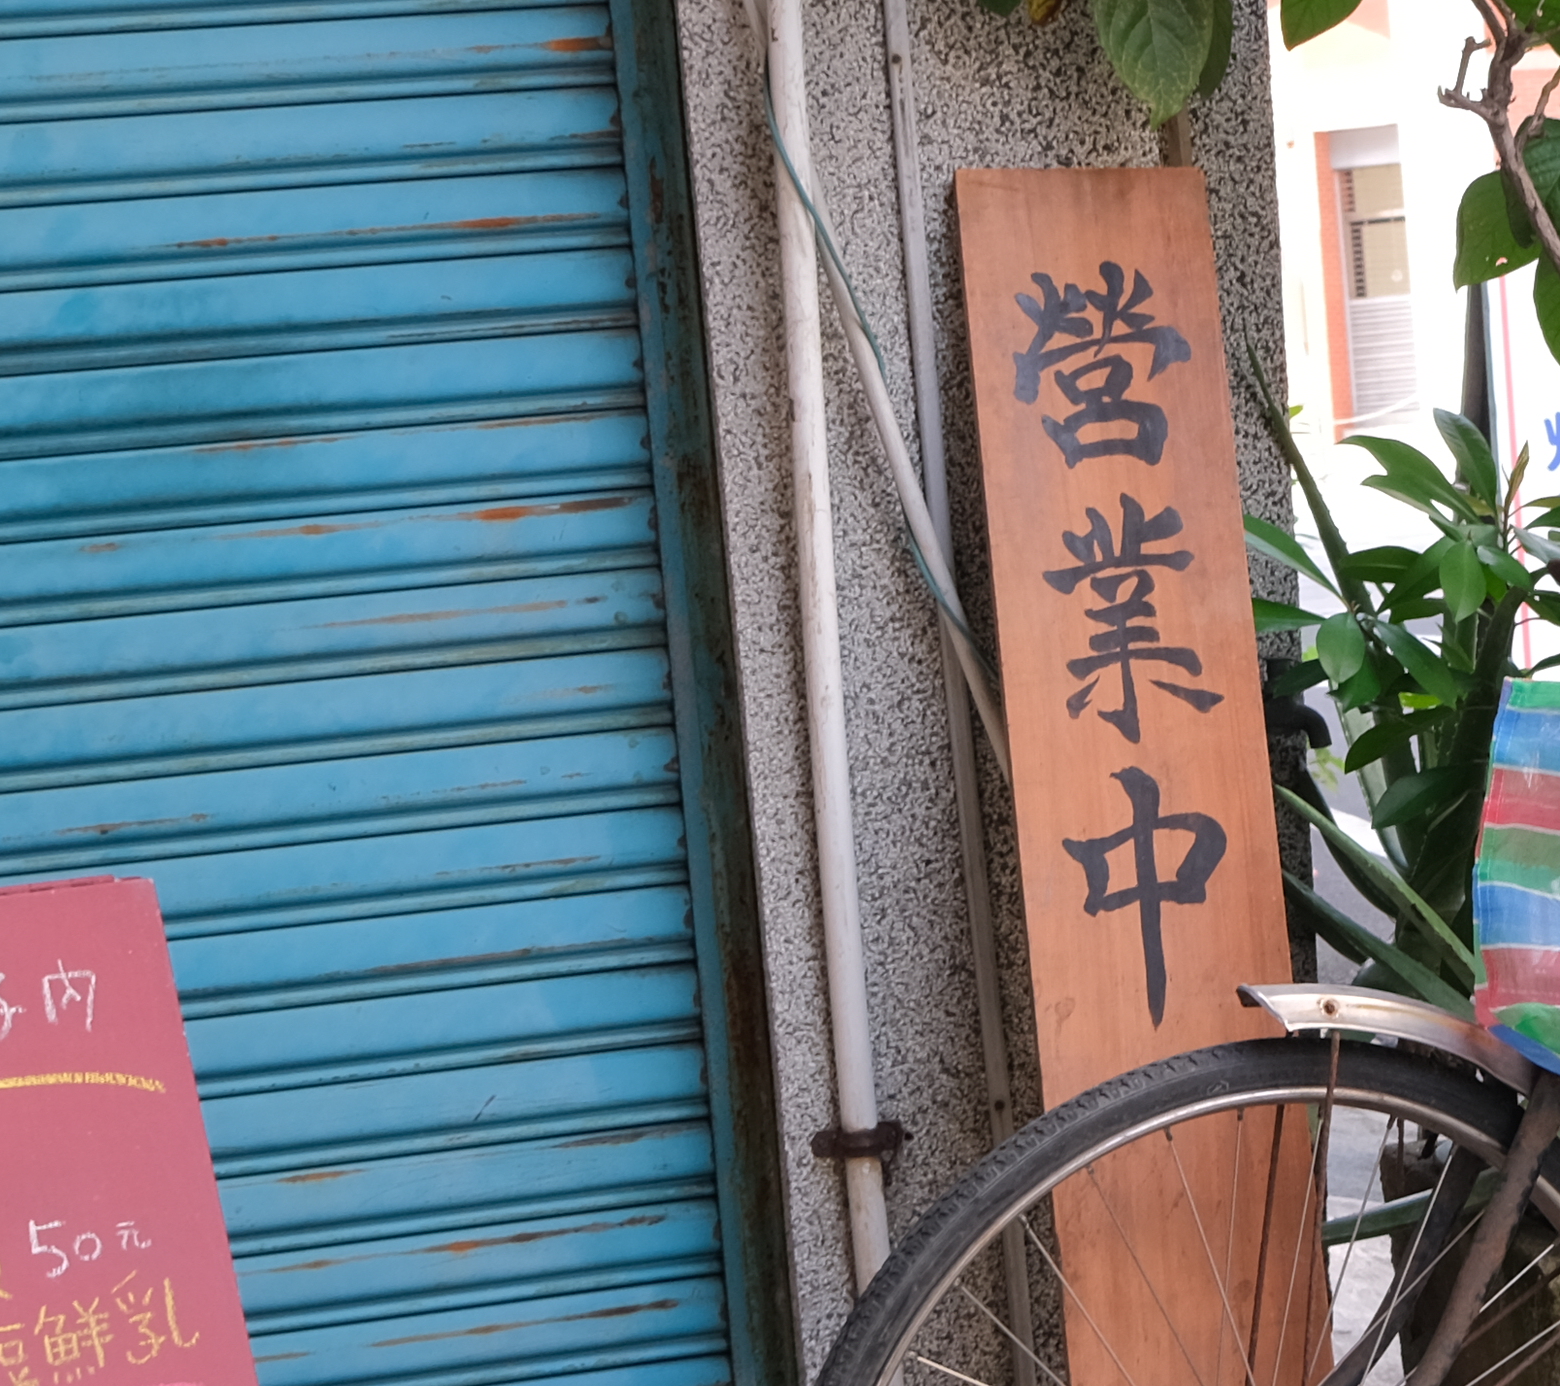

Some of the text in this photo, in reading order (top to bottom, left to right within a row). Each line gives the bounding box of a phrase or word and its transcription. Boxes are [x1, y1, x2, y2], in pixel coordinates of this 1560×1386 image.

[1013, 260, 1228, 1031] 營業中
[27, 1219, 153, 1278] 50元
